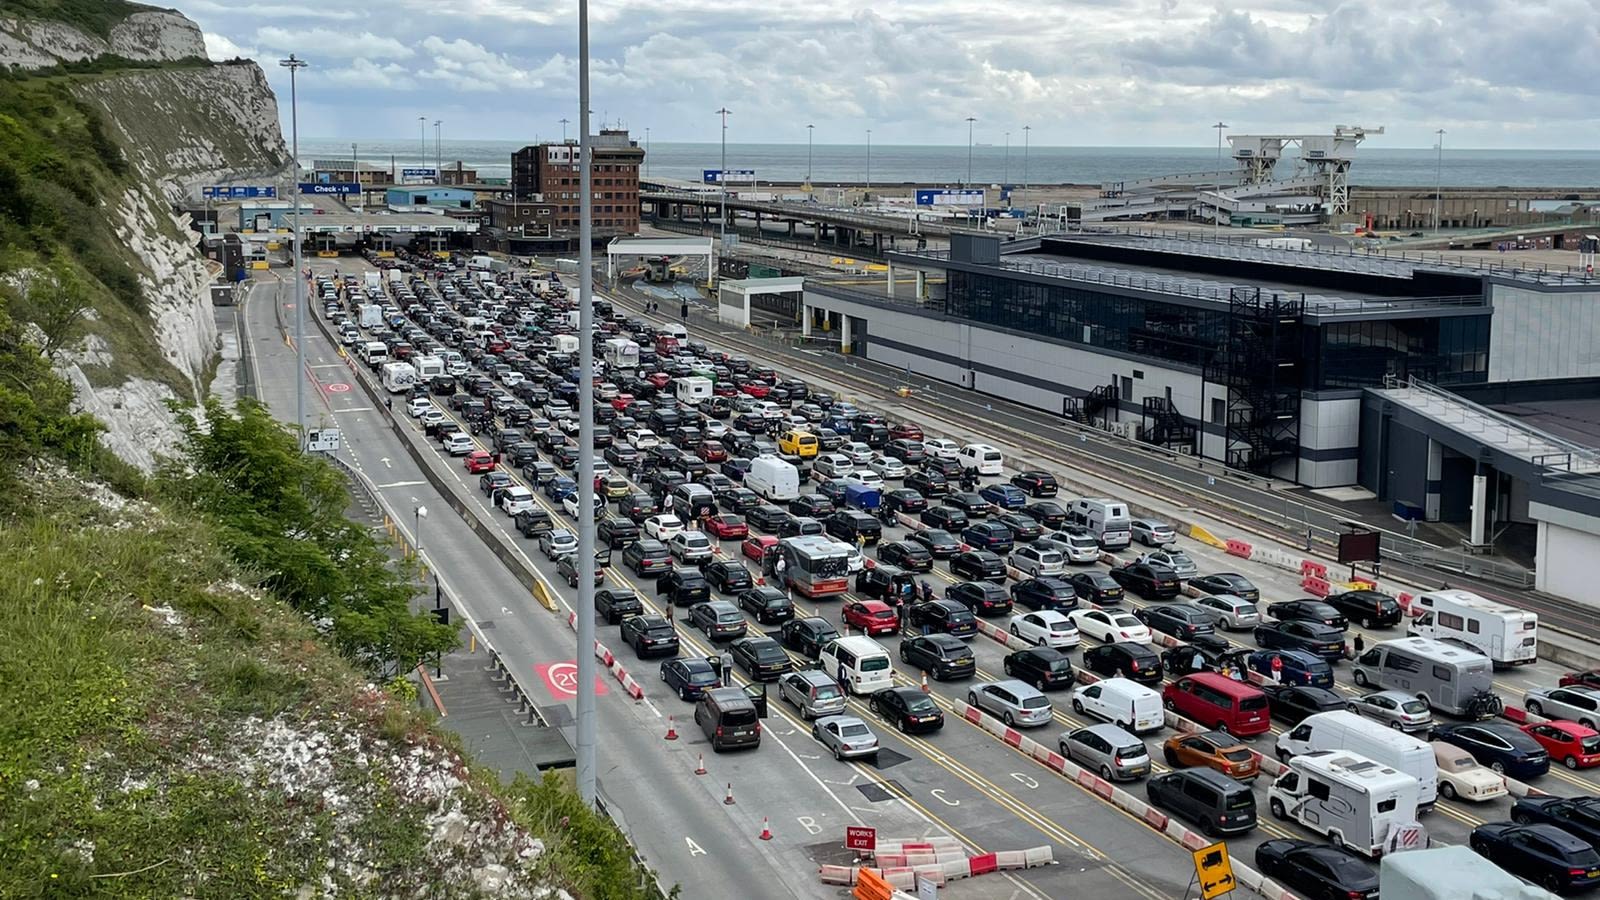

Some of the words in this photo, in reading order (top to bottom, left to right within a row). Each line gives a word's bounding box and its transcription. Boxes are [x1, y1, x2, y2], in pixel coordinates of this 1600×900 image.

[314, 185, 337, 193] Check
[1010, 773, 1039, 789] D
[931, 789, 960, 806] C
[797, 816, 823, 835] B
[849, 829, 874, 838] WORKS
[685, 836, 707, 857] A
[854, 839, 868, 847] EXIT
